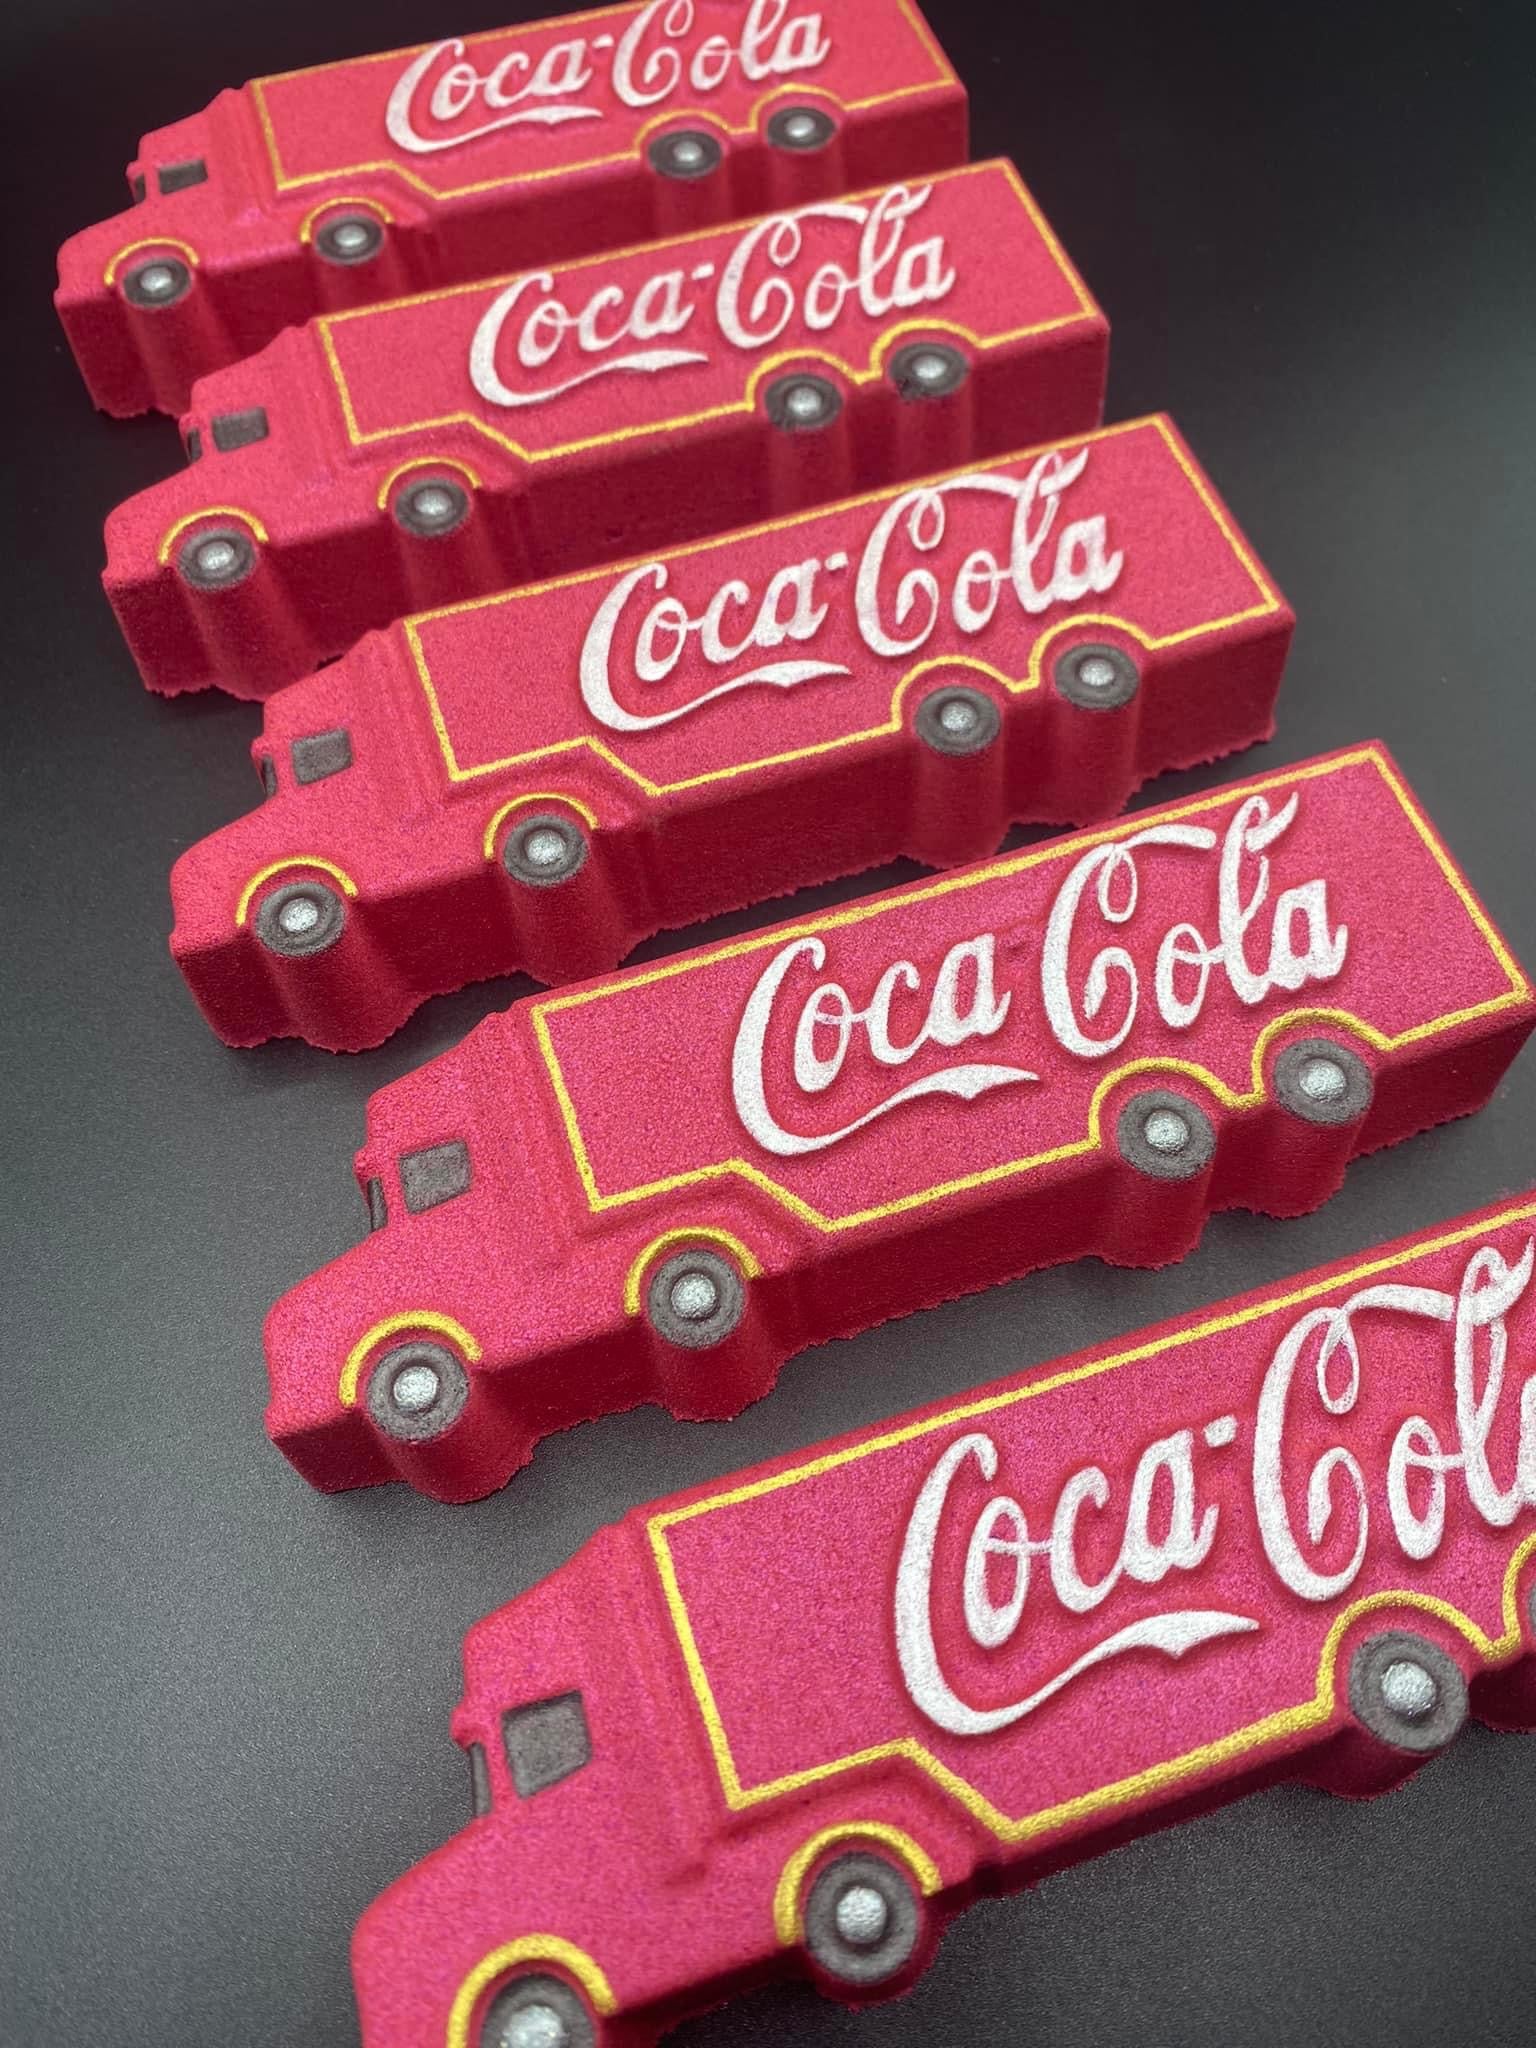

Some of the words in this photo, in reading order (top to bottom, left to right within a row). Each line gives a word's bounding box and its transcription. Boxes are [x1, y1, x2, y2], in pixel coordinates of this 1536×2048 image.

[385, 0, 831, 153] Coca-Cola
[469, 181, 956, 407] Coca-Cola
[579, 447, 1124, 731] Coca-Cola
[893, 1235, 1536, 1736] Coca-Col
